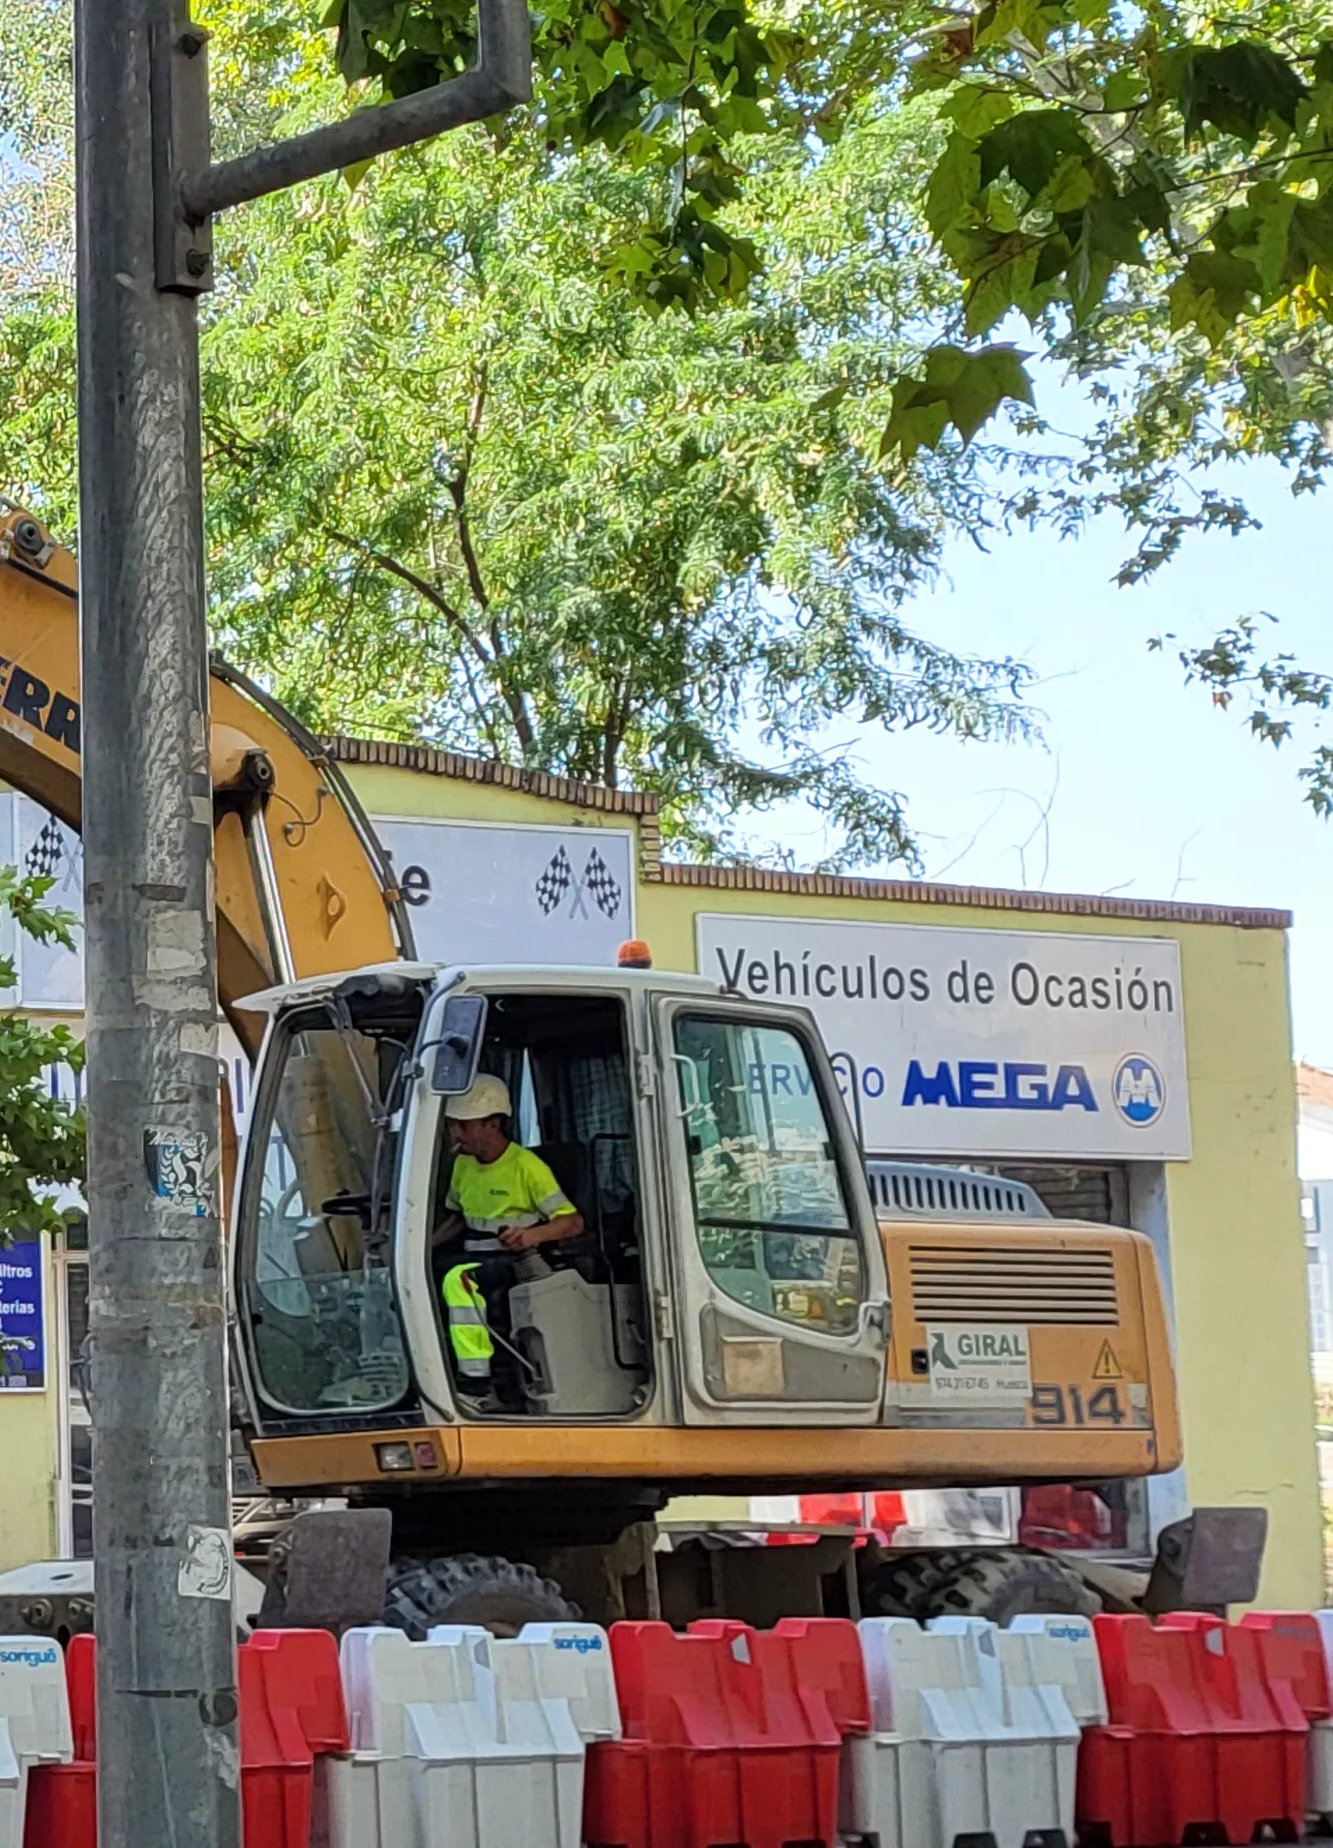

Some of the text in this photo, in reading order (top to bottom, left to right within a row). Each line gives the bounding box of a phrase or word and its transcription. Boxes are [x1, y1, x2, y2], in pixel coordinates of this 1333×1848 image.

[715, 947, 1174, 1013] Vehículos de Ocasión
[900, 1060, 1100, 1112] MEGA
[958, 1334, 1027, 1356] GIRAL
